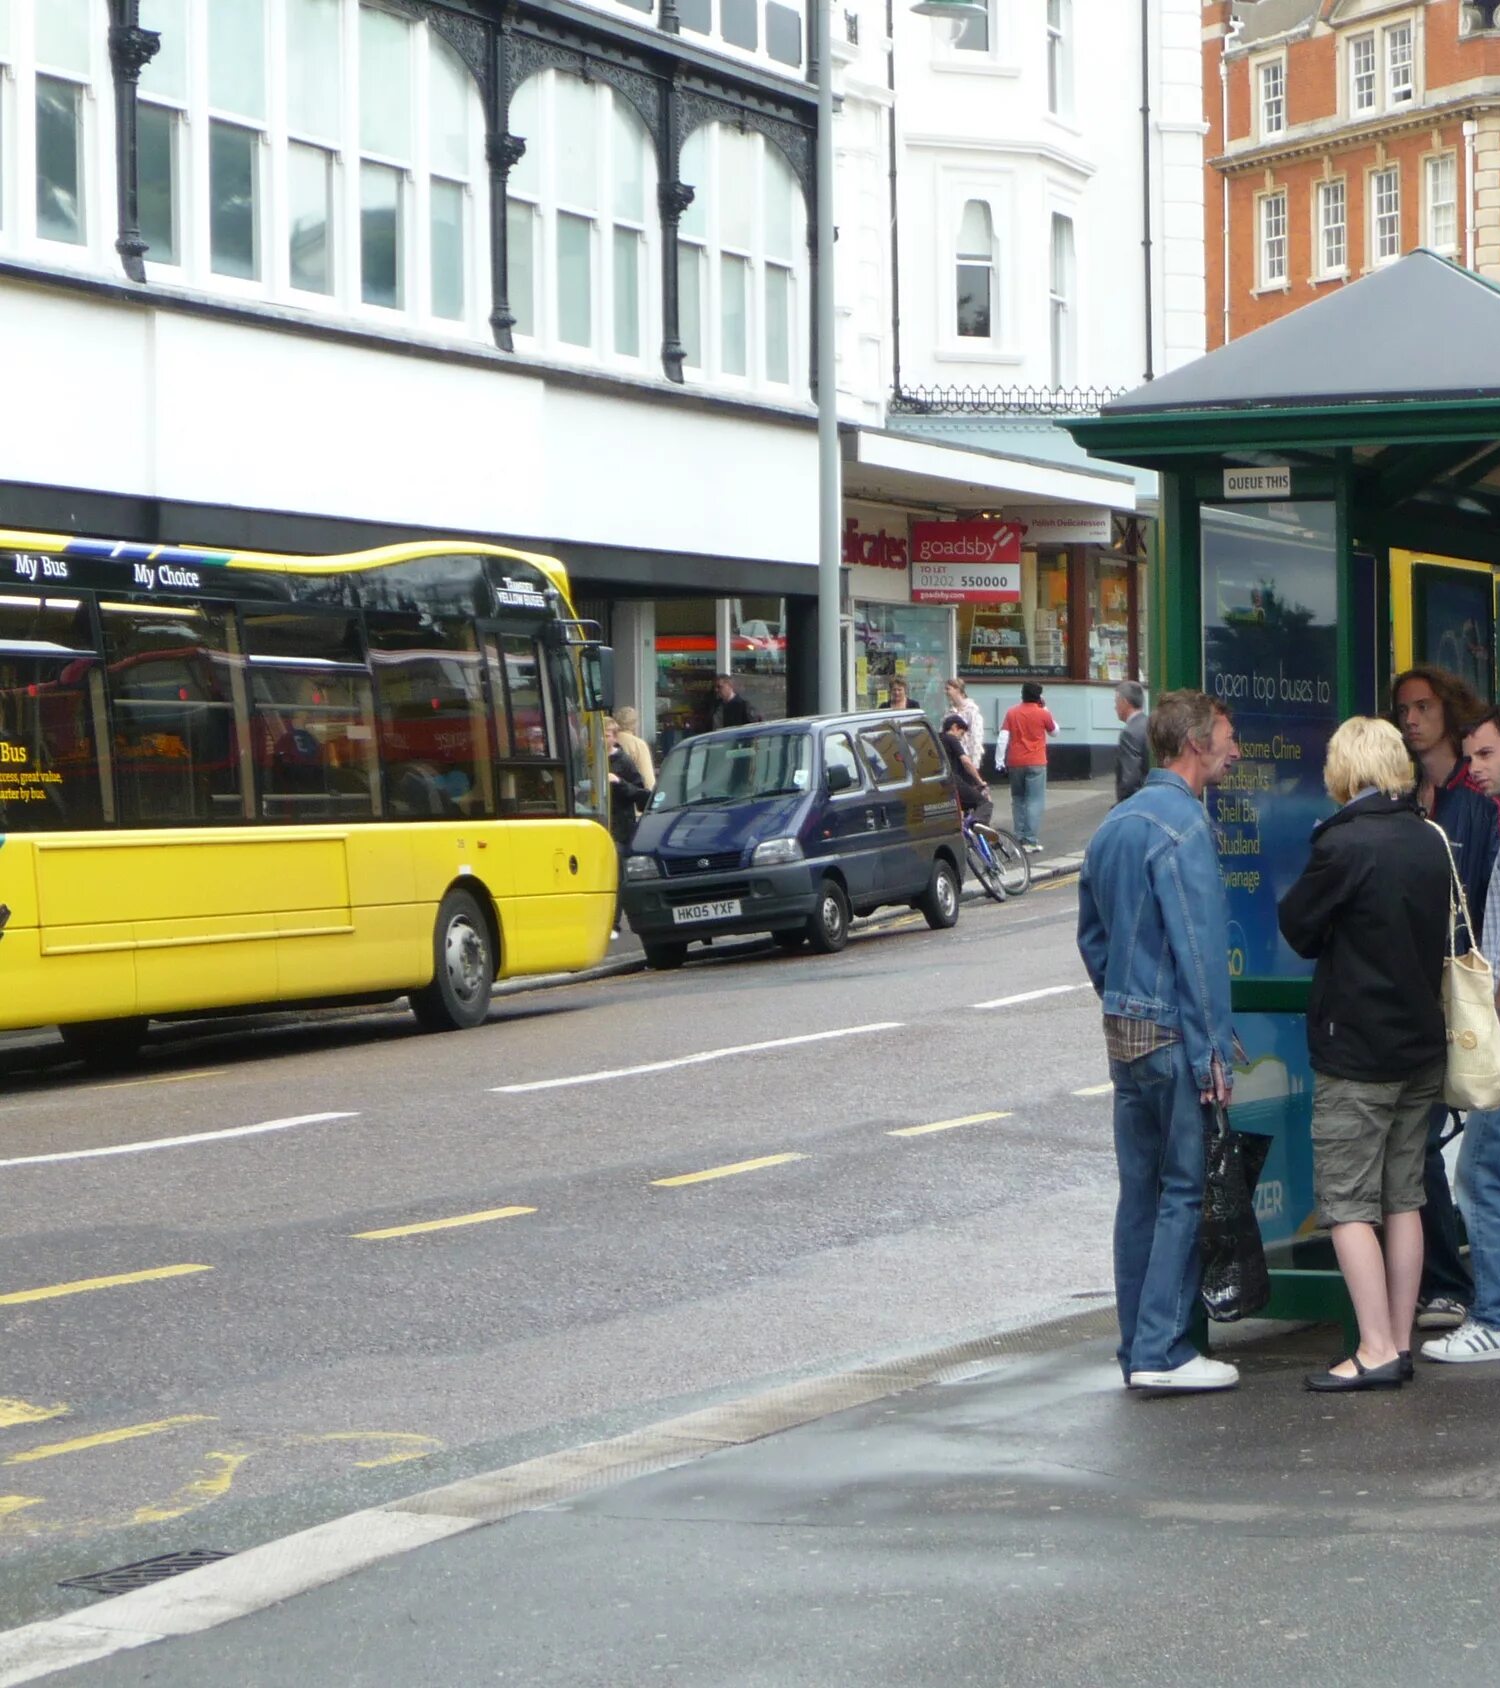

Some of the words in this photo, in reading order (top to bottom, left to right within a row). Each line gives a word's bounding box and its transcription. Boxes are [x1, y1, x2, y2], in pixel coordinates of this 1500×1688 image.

[1228, 477, 1263, 490] QUEUE
[1264, 475, 1289, 489] THIS
[919, 536, 998, 560] goadsby
[15, 554, 38, 581] My
[41, 555, 69, 577] Bus
[133, 563, 155, 589] My
[158, 565, 200, 587] Choice
[919, 566, 932, 574] TO
[932, 566, 947, 574] LET
[920, 575, 955, 588] 01202
[960, 576, 1008, 588] 550000
[919, 591, 965, 600] goadsby.com
[1215, 671, 1249, 702] open
[1253, 670, 1276, 706] top
[1279, 662, 1314, 704] buses
[1316, 675, 1331, 704] to
[0, 742, 27, 763] Bus
[1239, 731, 1270, 759] ksome
[1272, 732, 1302, 760] Chine
[20, 770, 40, 786] great
[40, 770, 63, 784] value,
[20, 787, 31, 804] by
[1217, 799, 1242, 824] Shell
[1242, 799, 1260, 827] Bay
[1217, 829, 1260, 856] Studland
[676, 904, 709, 920] HK05
[710, 901, 735, 916] YXF
